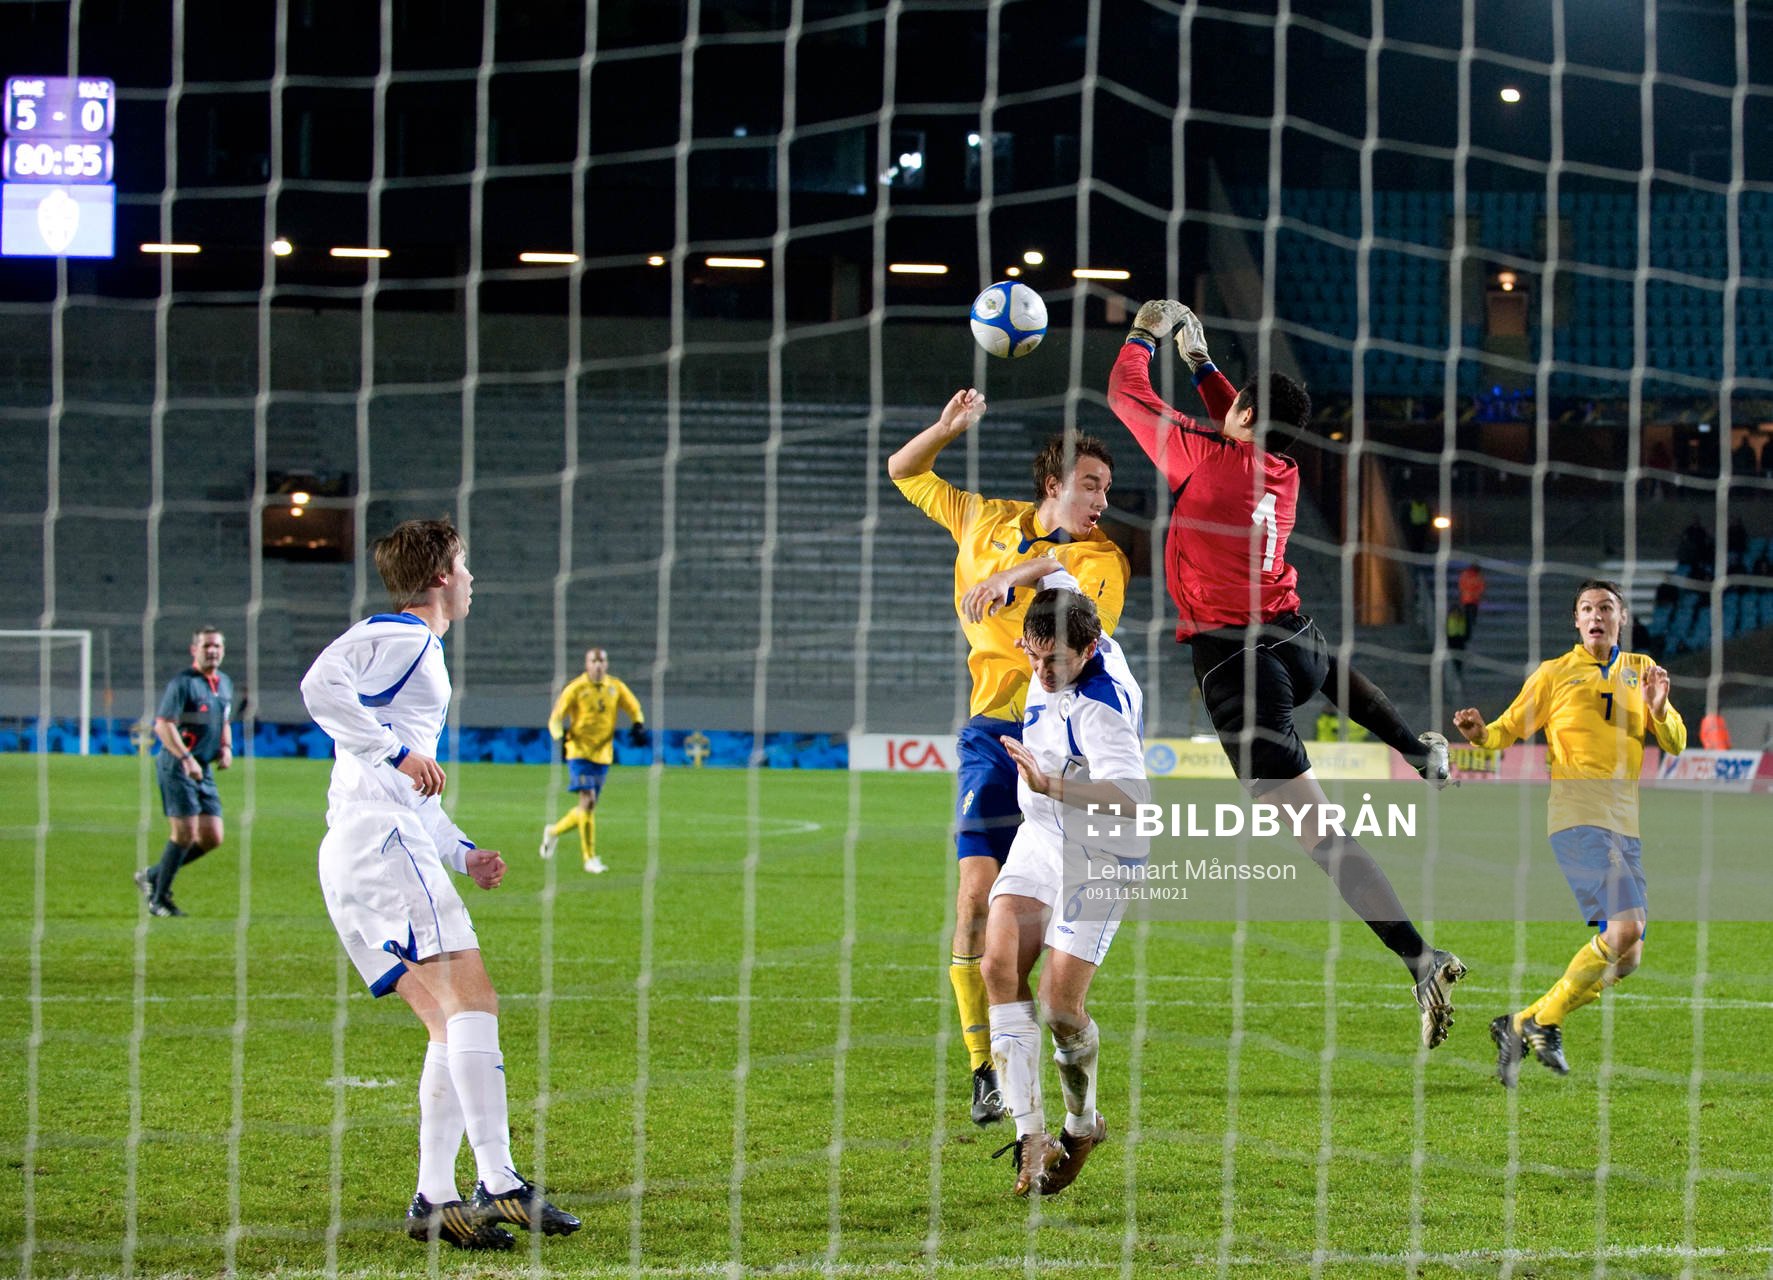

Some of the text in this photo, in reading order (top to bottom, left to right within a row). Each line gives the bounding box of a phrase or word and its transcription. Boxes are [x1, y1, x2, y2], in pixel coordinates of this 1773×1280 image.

[16, 99, 37, 131] 5
[81, 100, 105, 132] 0
[14, 143, 103, 176] 80:55
[1251, 492, 1278, 572] 1
[1601, 693, 1614, 721] 7
[887, 740, 947, 769] ICA
[1063, 884, 1086, 923] 6
